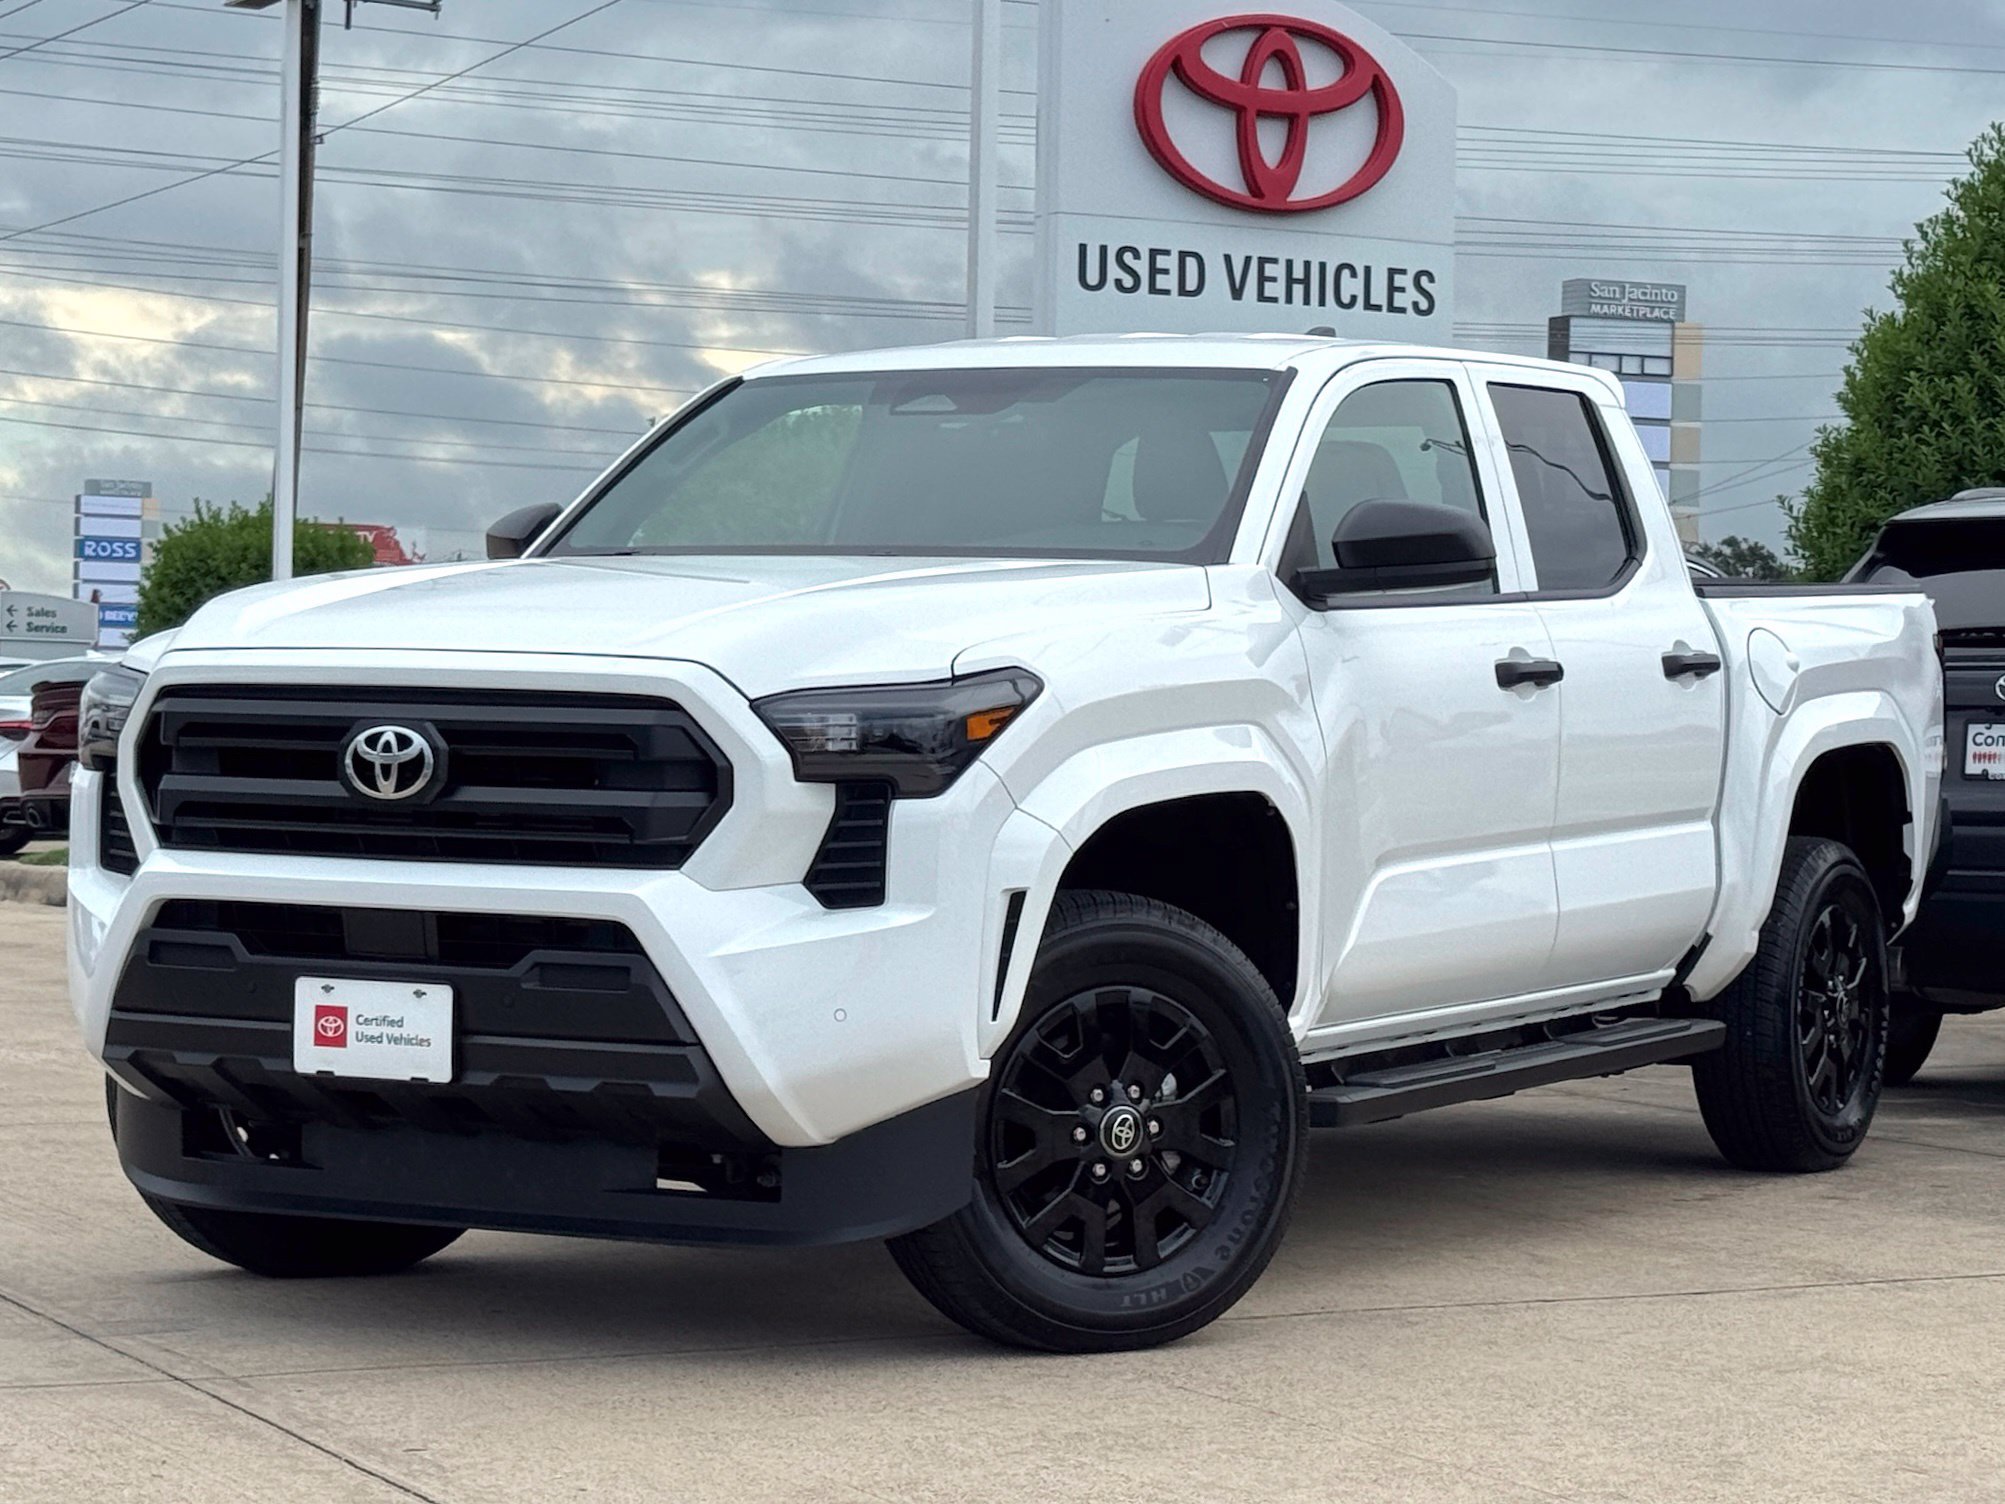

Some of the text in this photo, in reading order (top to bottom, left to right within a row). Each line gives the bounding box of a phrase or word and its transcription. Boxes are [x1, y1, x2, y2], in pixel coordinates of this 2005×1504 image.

[1077, 243, 1436, 317] USED VEHICLES
[1590, 281, 1678, 303] San Jacinto
[1589, 303, 1677, 320] MARKETPLACE
[84, 541, 137, 558] ROSS
[26, 606, 57, 618] Sales
[26, 621, 68, 634] Service
[355, 1014, 404, 1028] Certified
[355, 1031, 432, 1048] Used Vehicles
